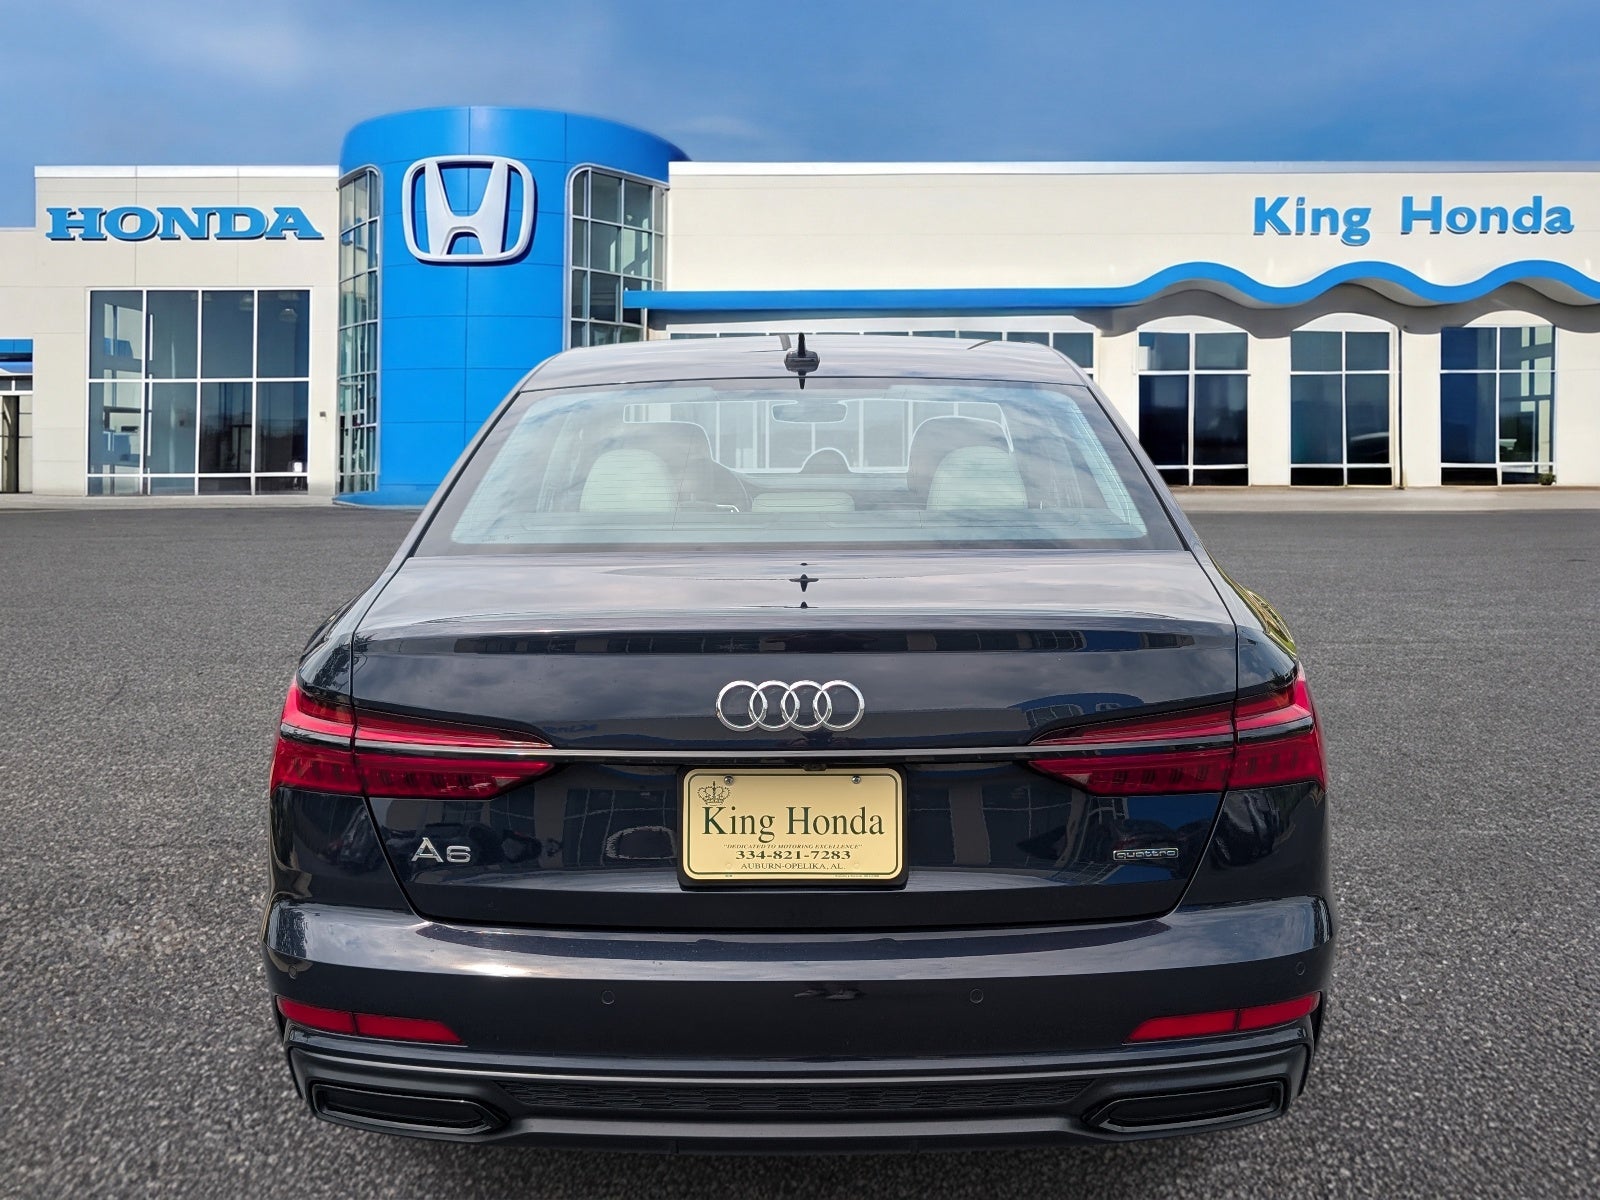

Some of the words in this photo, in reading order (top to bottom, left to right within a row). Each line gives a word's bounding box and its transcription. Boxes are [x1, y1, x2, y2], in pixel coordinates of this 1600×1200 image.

[45, 206, 324, 241] HONDA
[1254, 196, 1372, 246] King
[1400, 195, 1575, 235] Honda
[702, 806, 776, 843] King
[785, 806, 885, 835] Honda
[411, 837, 471, 863] A6
[735, 850, 851, 860] 334-821-7283
[1116, 850, 1176, 860] quattro
[740, 863, 829, 871] AUBURN-OPELIKA,
